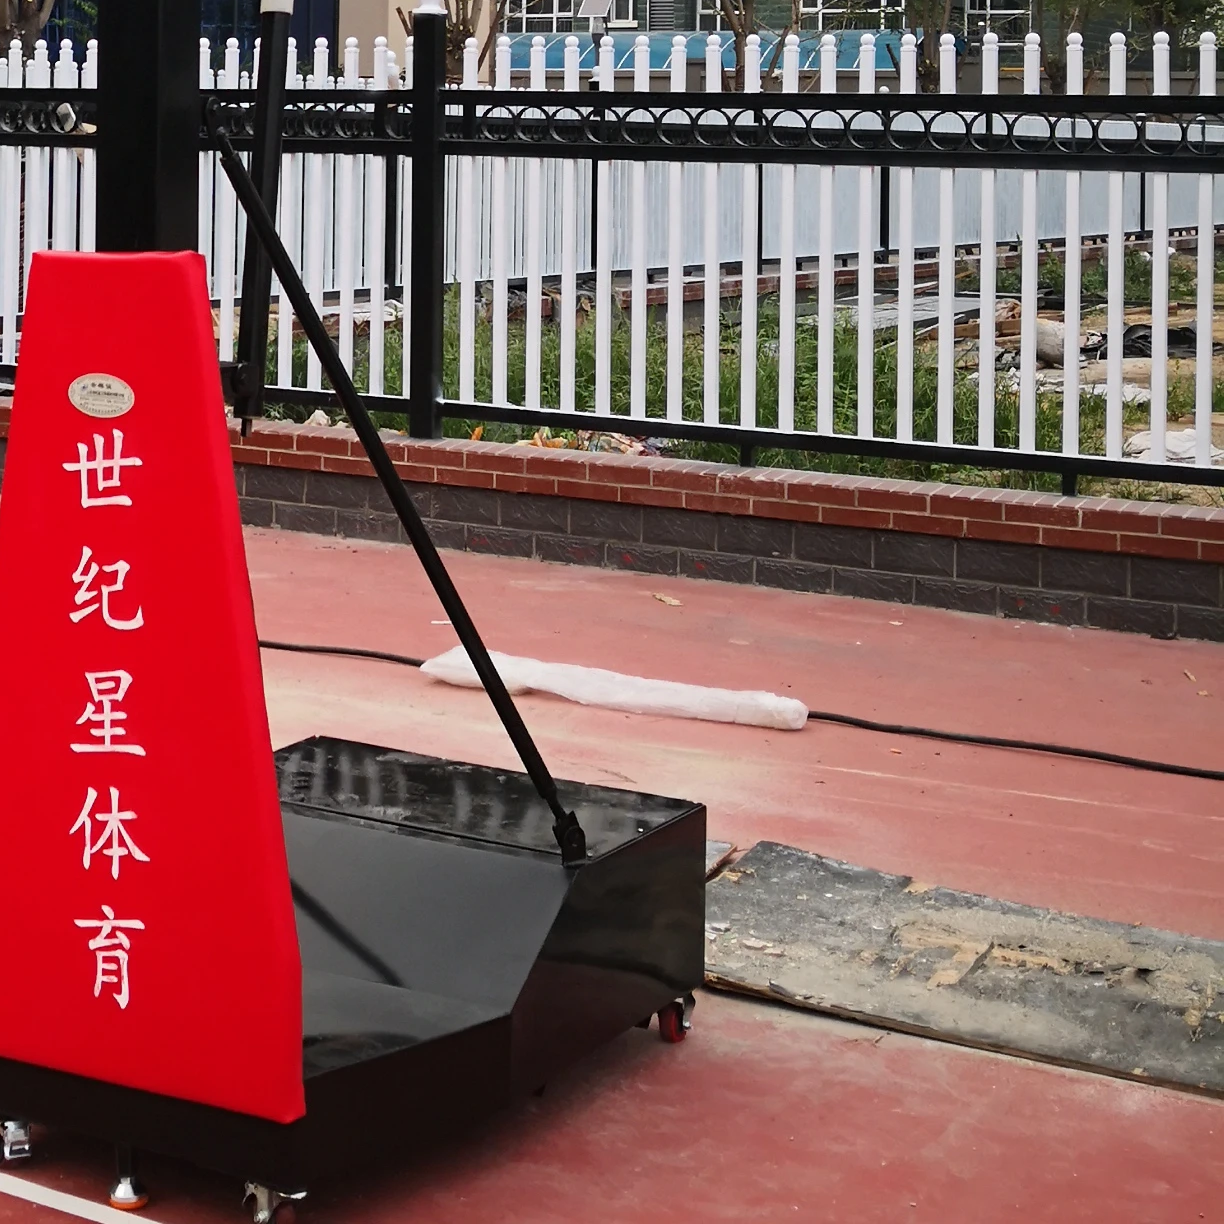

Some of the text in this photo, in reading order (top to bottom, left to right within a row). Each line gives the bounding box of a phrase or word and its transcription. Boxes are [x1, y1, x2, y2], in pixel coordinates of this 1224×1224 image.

[63, 429, 150, 1009] 世纪星体育
